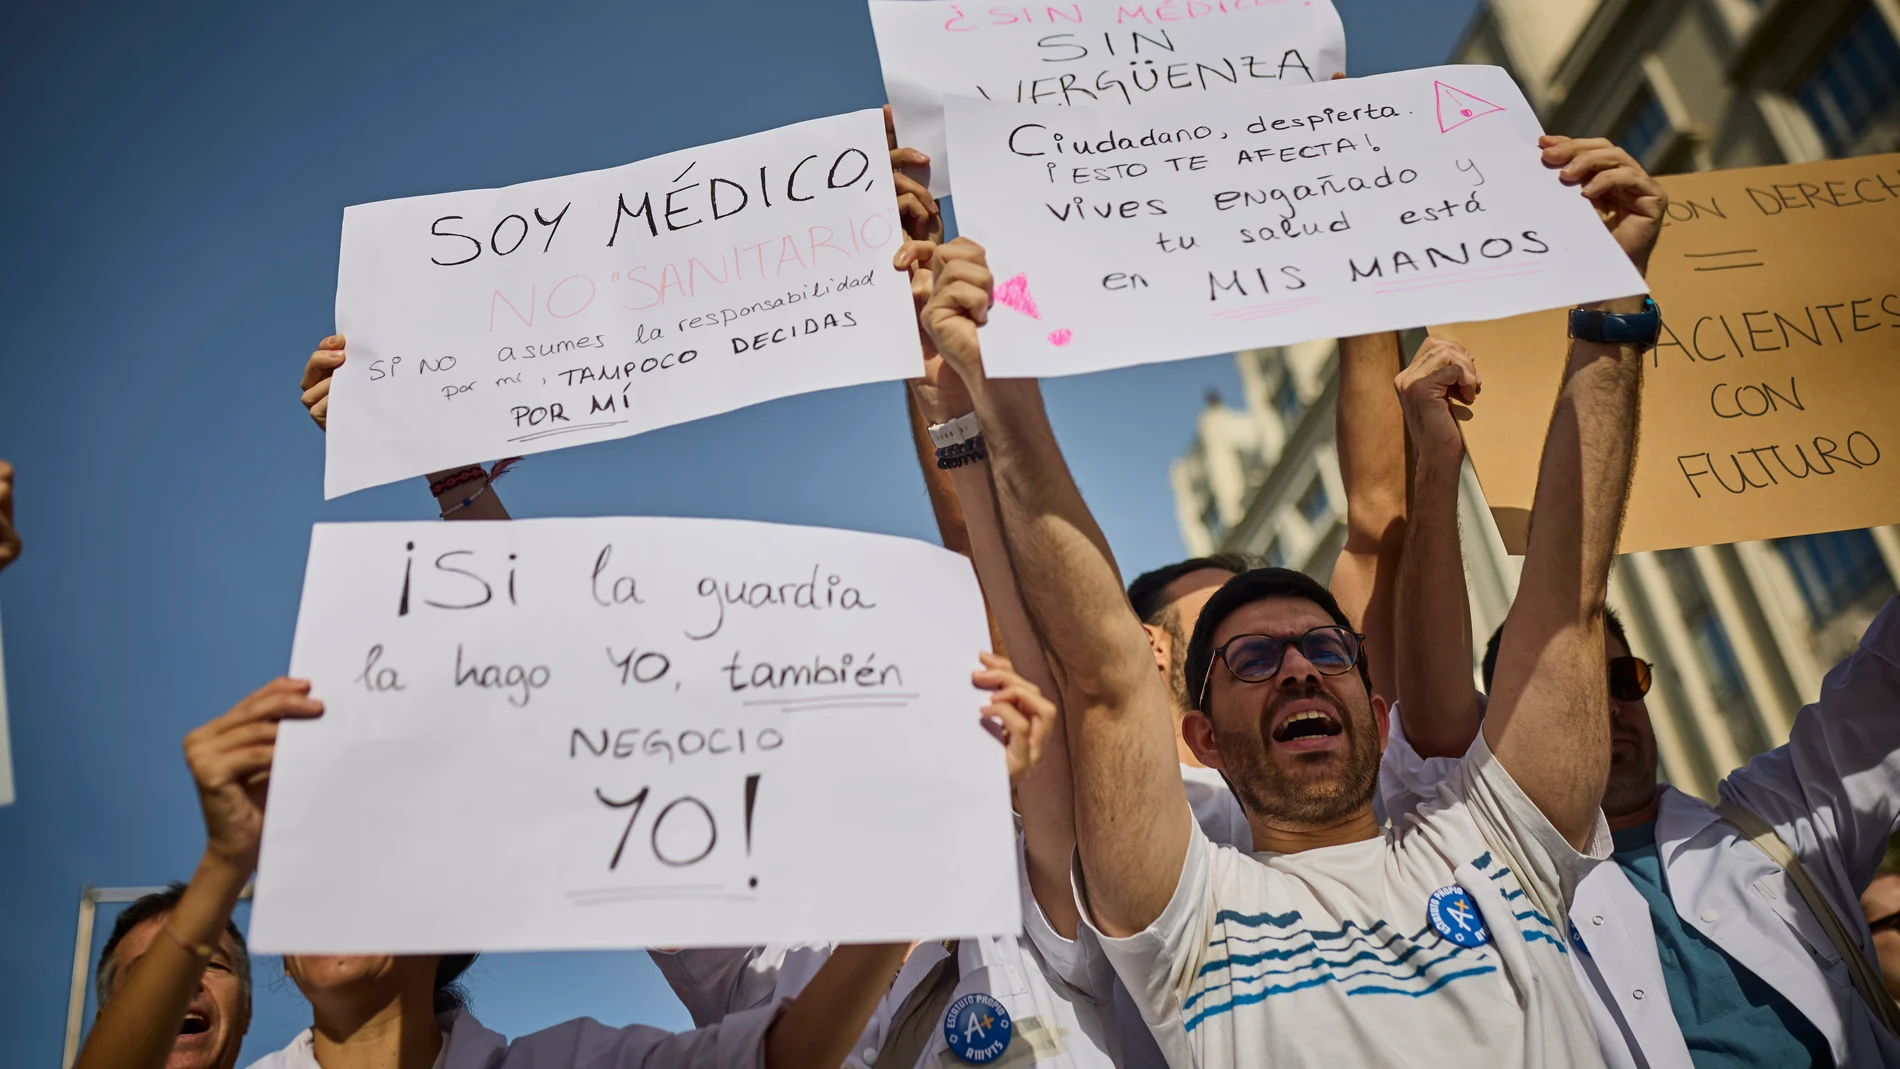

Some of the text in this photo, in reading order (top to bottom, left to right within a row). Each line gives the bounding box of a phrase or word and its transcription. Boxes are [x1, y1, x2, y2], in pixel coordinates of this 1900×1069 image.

[1036, 28, 1176, 62] SIN
[1007, 123, 1228, 157] Ciudadano,
[1046, 133, 1381, 185] ¡ESTO TE AFECTA!
[430, 147, 875, 267] SOY MÉDICO,
[1044, 196, 1168, 223] vives
[1455, 158, 1485, 187] y
[1155, 190, 1487, 254] tu salud está
[489, 206, 897, 332] NO "SANITARIO"
[1101, 229, 1550, 302] en MIS MANOS
[419, 355, 457, 376] NO
[497, 334, 605, 363] asumes
[634, 323, 665, 345] la
[678, 269, 876, 333] responsabilidad
[1654, 293, 1900, 368] ACIENTES
[440, 380, 477, 401] por
[556, 349, 698, 387] TAMPOCO
[730, 310, 858, 355] DECIDAS
[510, 381, 632, 428] POR MÍ
[1710, 375, 1806, 419] CON
[1676, 429, 1882, 499] FUTURO
[590, 543, 645, 605] la
[684, 563, 877, 642] guardia
[356, 643, 407, 693] la
[454, 644, 551, 708] hago
[721, 651, 903, 693] también
[569, 727, 784, 763] NEGOCIO
[593, 772, 763, 889] YO!
[1433, 886, 1463, 900] PROPIO
[946, 994, 1005, 1028] ESTATUTO PROPIO
